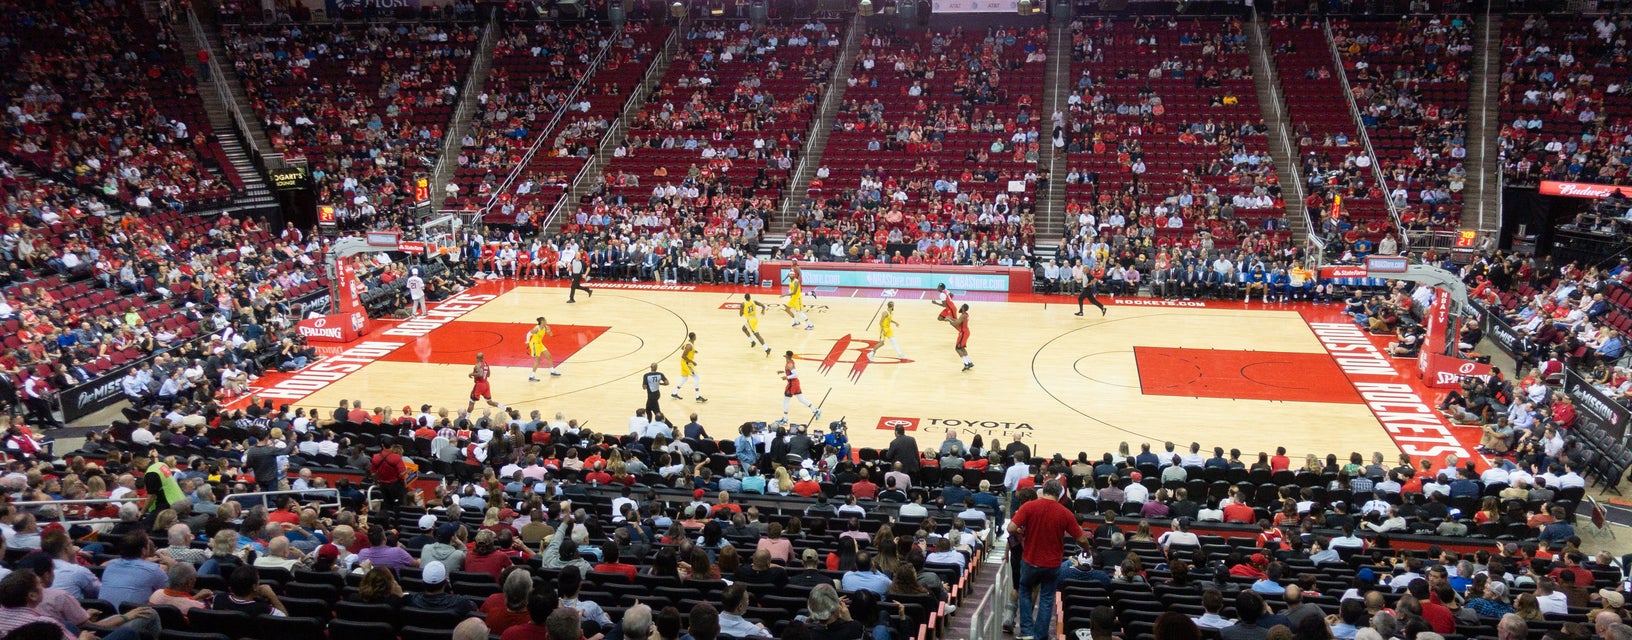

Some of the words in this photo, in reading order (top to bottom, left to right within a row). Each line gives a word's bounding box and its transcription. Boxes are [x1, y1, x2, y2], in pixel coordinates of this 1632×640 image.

[273, 173, 303, 181] OGART'S
[417, 188, 429, 200] 21
[1458, 238, 1471, 246] 21
[1115, 299, 1206, 307] ROCKETS.COM
[298, 326, 342, 339] SPALDING
[257, 341, 406, 399] HOUSTON
[381, 294, 498, 336] ROCKETS
[1309, 323, 1399, 376] HOUSTON
[1354, 382, 1471, 458] ROCKETS
[927, 418, 1034, 430] TOYOTA
